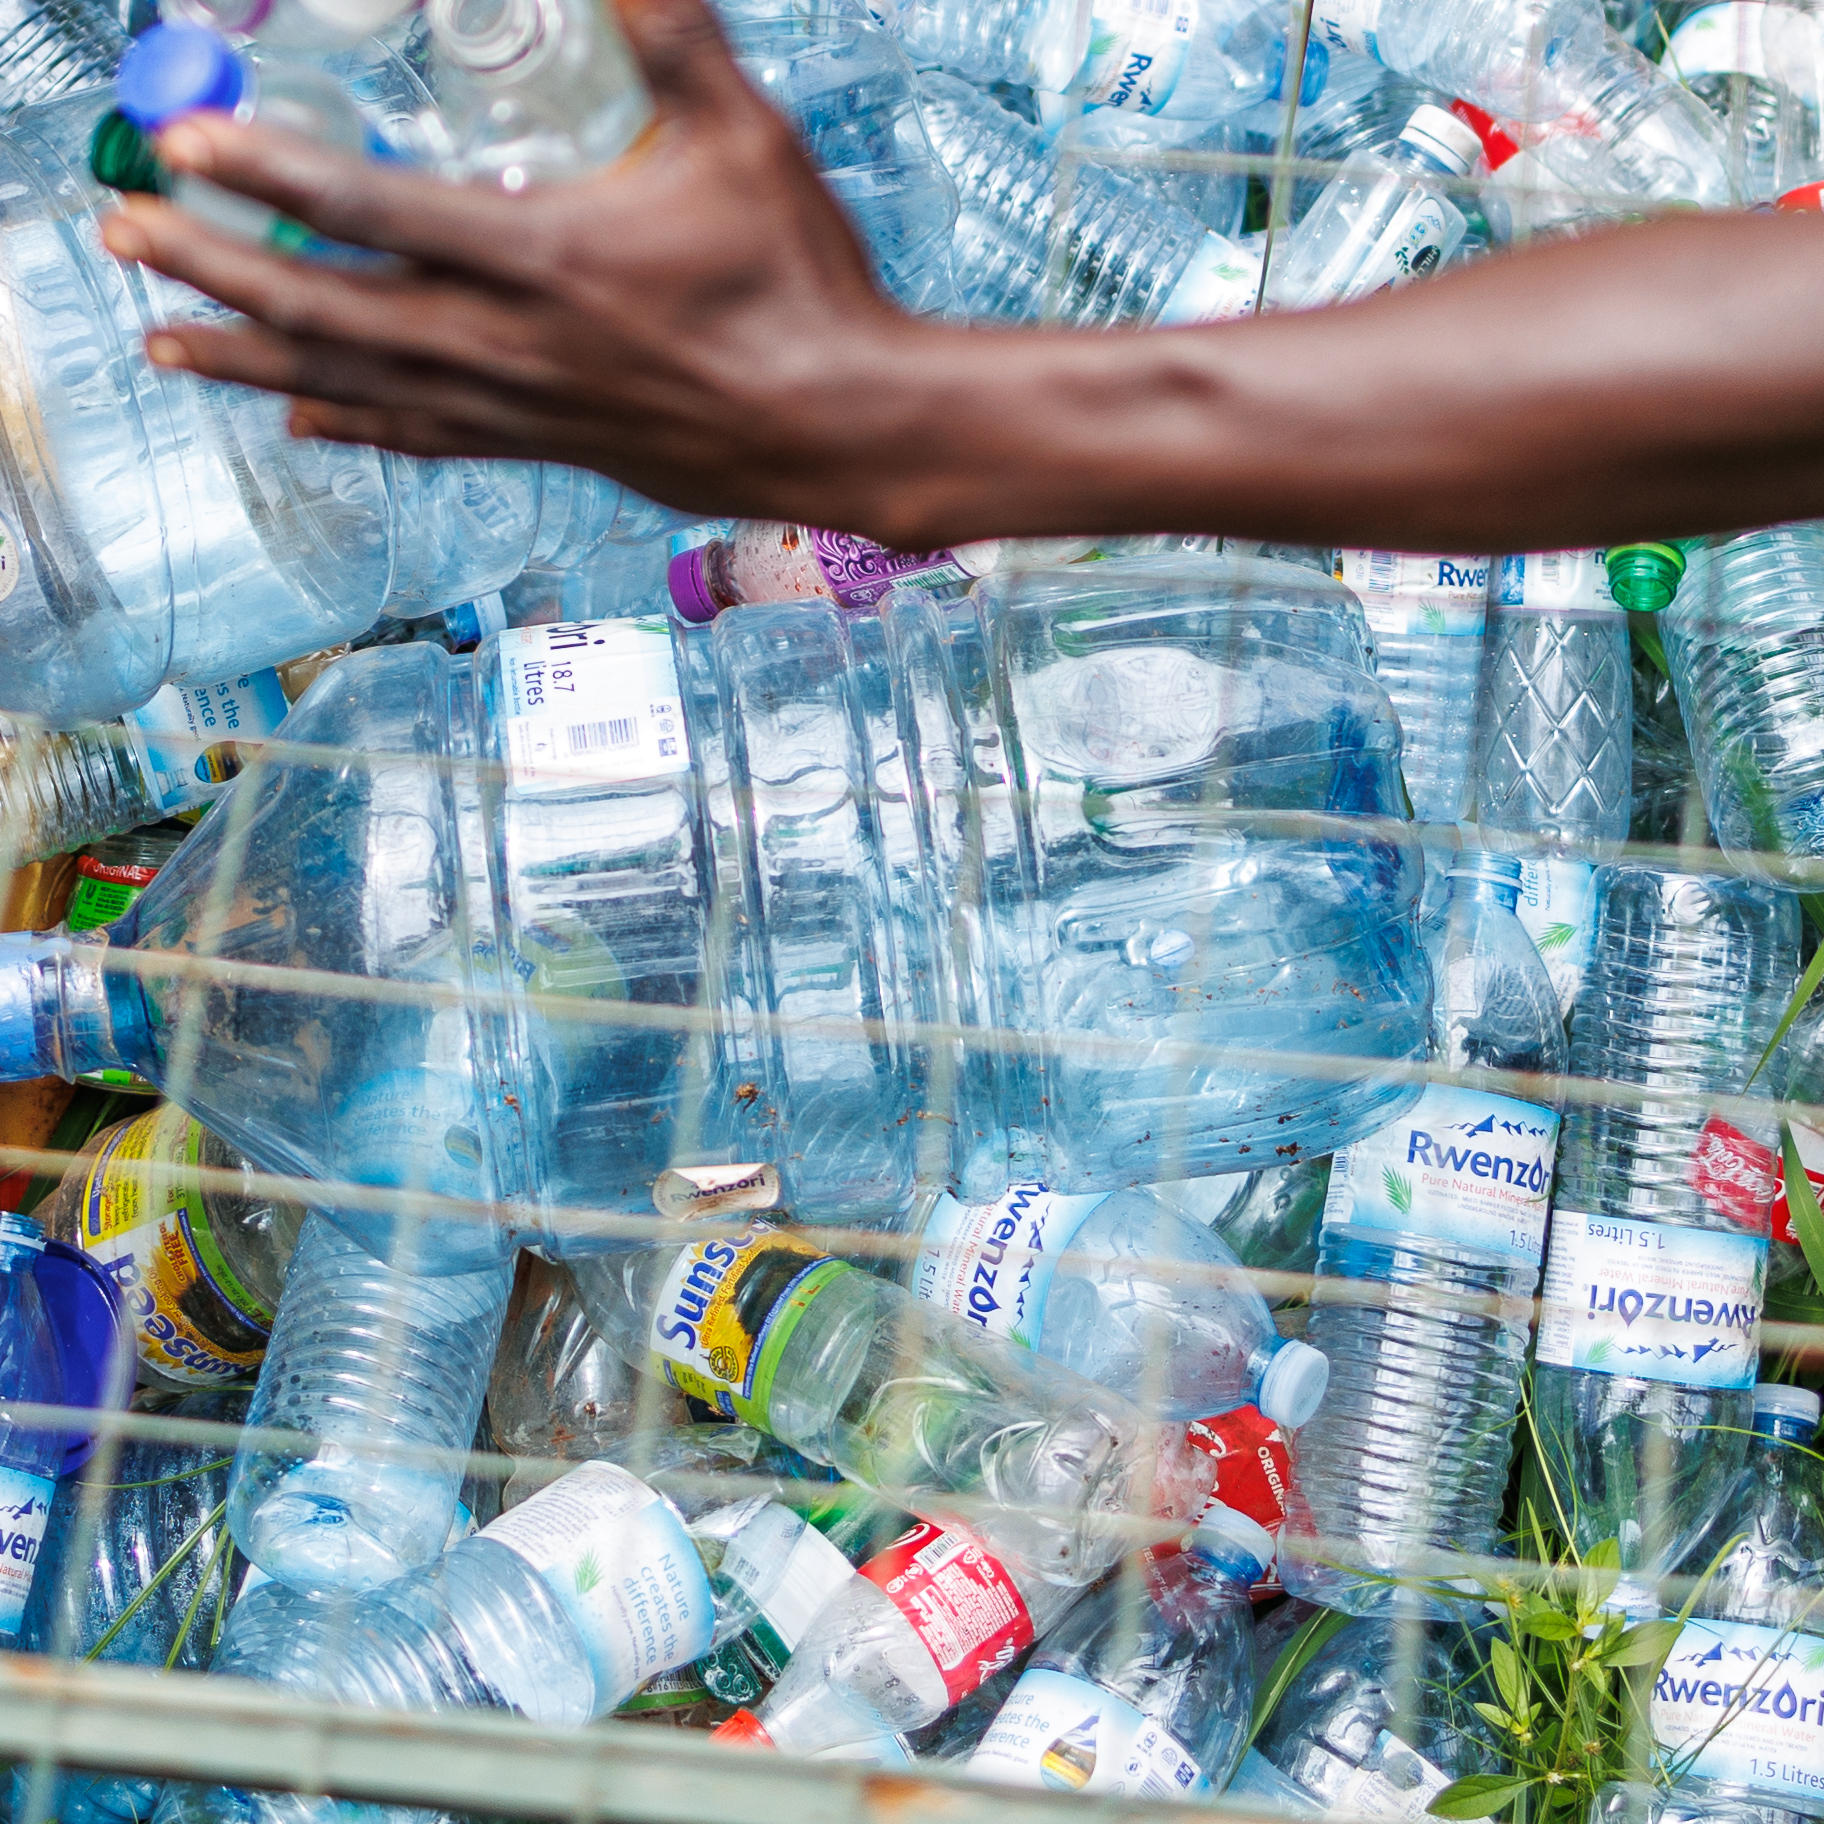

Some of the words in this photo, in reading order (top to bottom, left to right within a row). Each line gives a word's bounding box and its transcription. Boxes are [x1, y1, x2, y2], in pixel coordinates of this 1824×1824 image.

[523, 660, 546, 707] litres
[550, 661, 576, 693] 18.7
[1421, 1172, 1450, 1189] Pure
[1451, 1178, 1497, 1199] Natural
[168, 1226, 189, 1268] FREE
[1509, 1228, 1527, 1249] 1.5
[1587, 1222, 1634, 1247] Litres
[1638, 1231, 1666, 1251] 1.5
[922, 1248, 941, 1277] 1.5
[955, 1240, 979, 1287] Mineral
[966, 1183, 1050, 1328] wenzor
[918, 1277, 934, 1300] Lit
[1598, 1267, 1635, 1283] Water
[1637, 1273, 1684, 1290] Mineral
[1689, 1281, 1729, 1297] Natural
[706, 1293, 726, 1329] Refined
[721, 1259, 745, 1296] Fortified
[1588, 1283, 1756, 1340] Rwenzori
[657, 1552, 690, 1621] Nature
[622, 1576, 658, 1666] difference
[640, 1565, 673, 1633] creates
[663, 1633, 679, 1662] the
[1024, 1712, 1050, 1733] the
[1660, 1708, 1682, 1723] Pure
[1780, 1724, 1816, 1743] Water
[1749, 1757, 1778, 1779] 1.5
